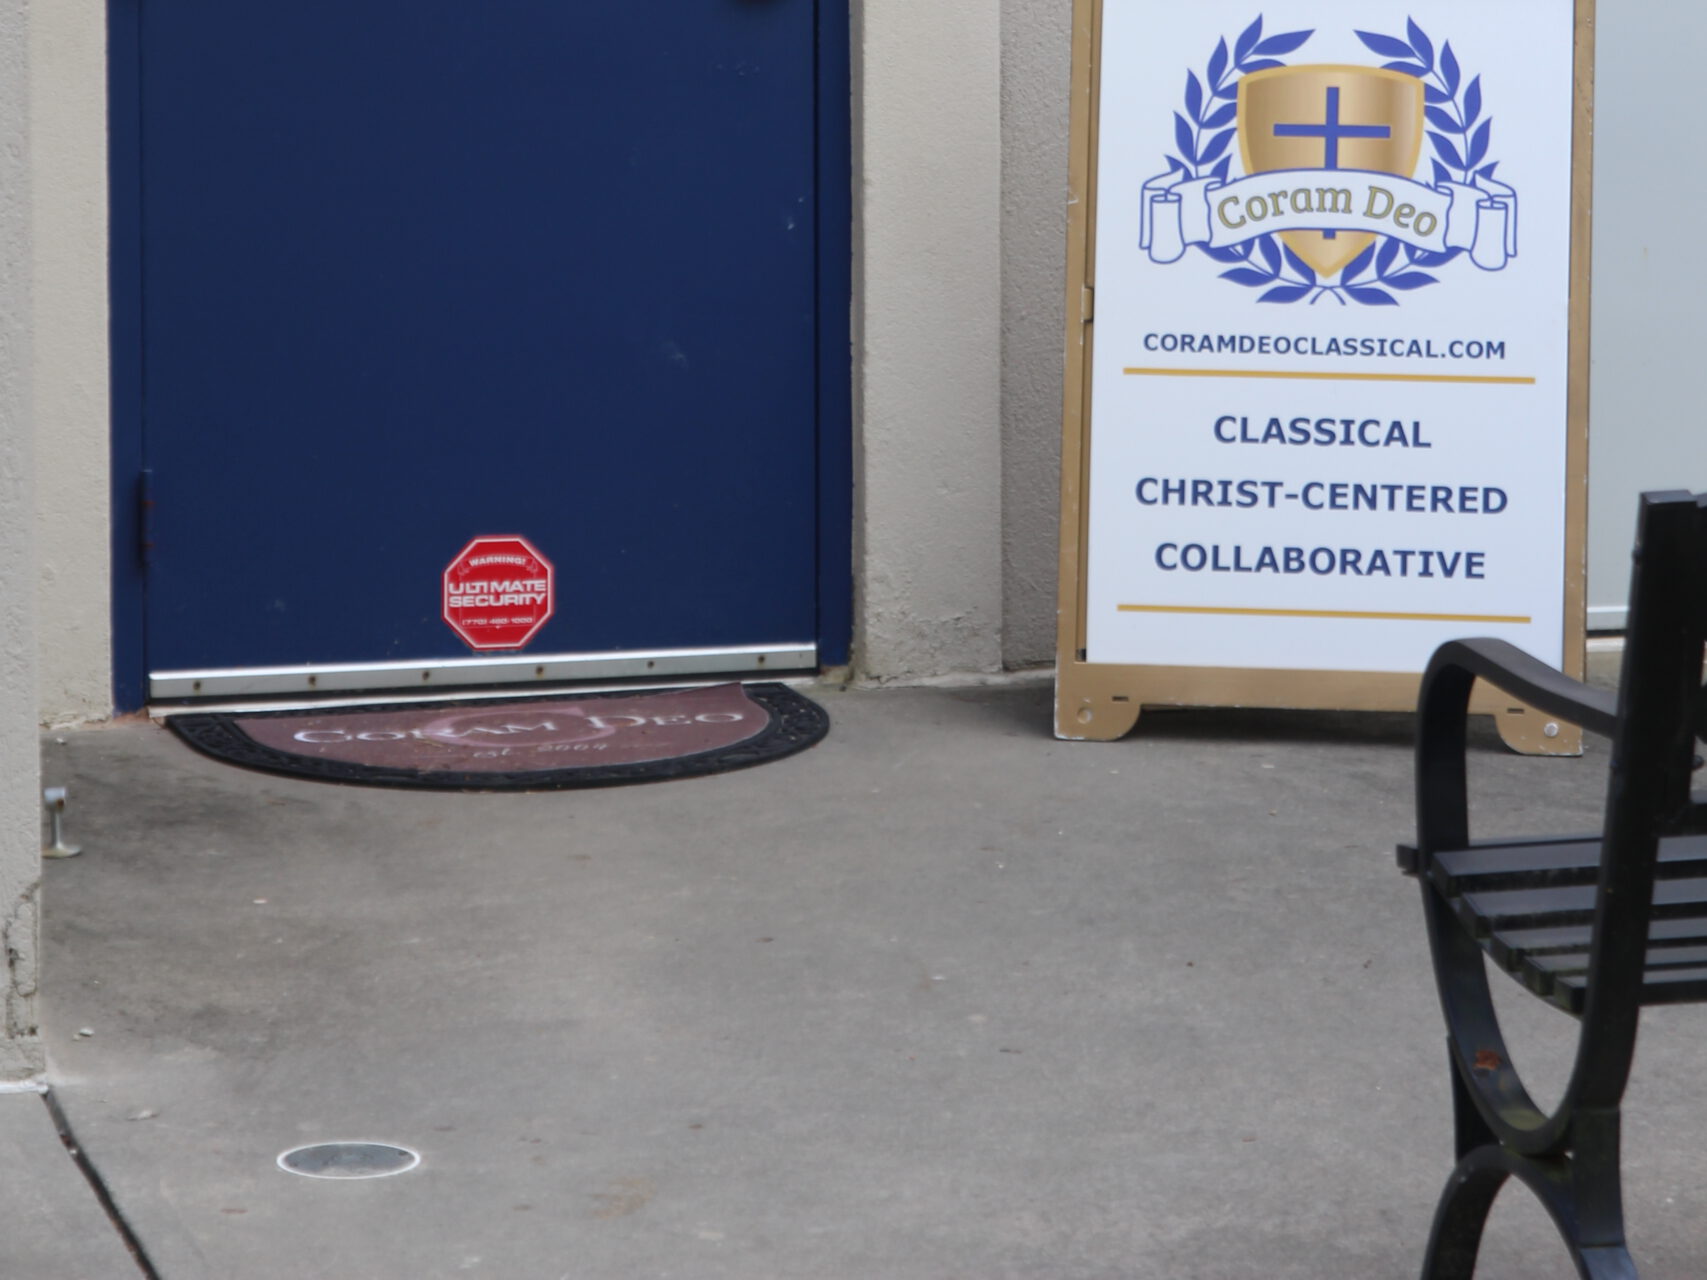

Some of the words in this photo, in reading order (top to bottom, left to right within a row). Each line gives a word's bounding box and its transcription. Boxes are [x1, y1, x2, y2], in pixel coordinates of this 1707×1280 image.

[1216, 185, 1353, 230] Coram
[1363, 184, 1439, 238] Deo
[1142, 332, 1507, 360] CORAMDEOCLASSICAL.COM
[1212, 414, 1432, 449] CLASSICAL
[1134, 476, 1509, 515] CHRIST-CENTERED
[1153, 541, 1486, 580] COLLABORATIVE
[448, 579, 547, 595] ULTIMATE
[448, 592, 547, 608] SECURITY
